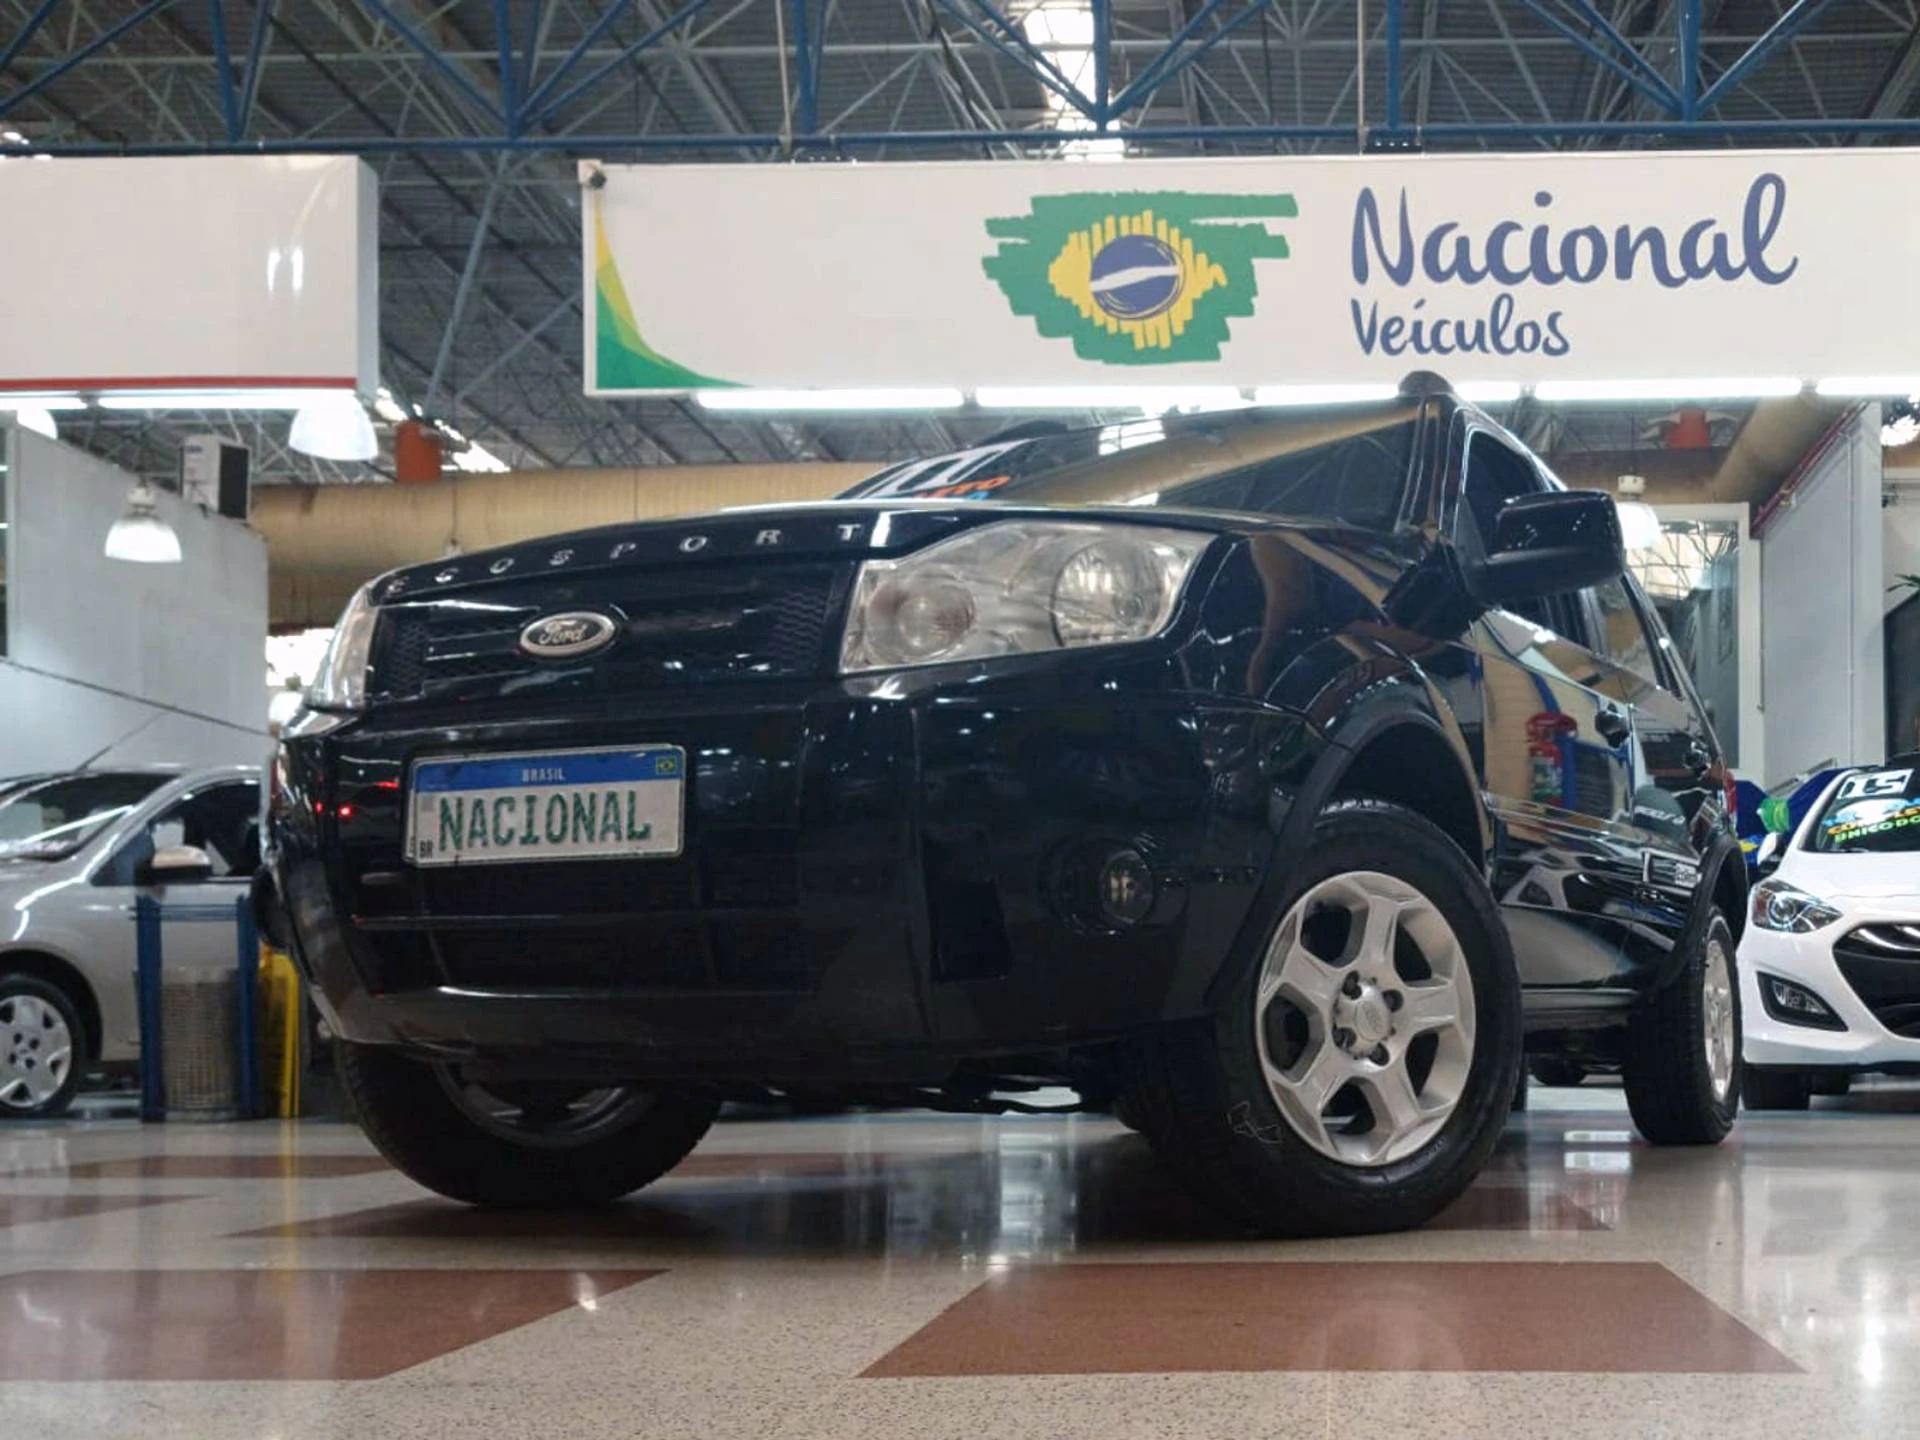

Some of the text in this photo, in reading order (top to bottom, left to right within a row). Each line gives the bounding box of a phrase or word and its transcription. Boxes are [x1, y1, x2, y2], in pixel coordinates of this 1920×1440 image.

[1350, 172, 1799, 288] Nacional
[1350, 292, 1571, 357] Veículos
[538, 619, 588, 646] Ford
[521, 767, 567, 783] BRASIL
[438, 789, 652, 851] NACIONAL
